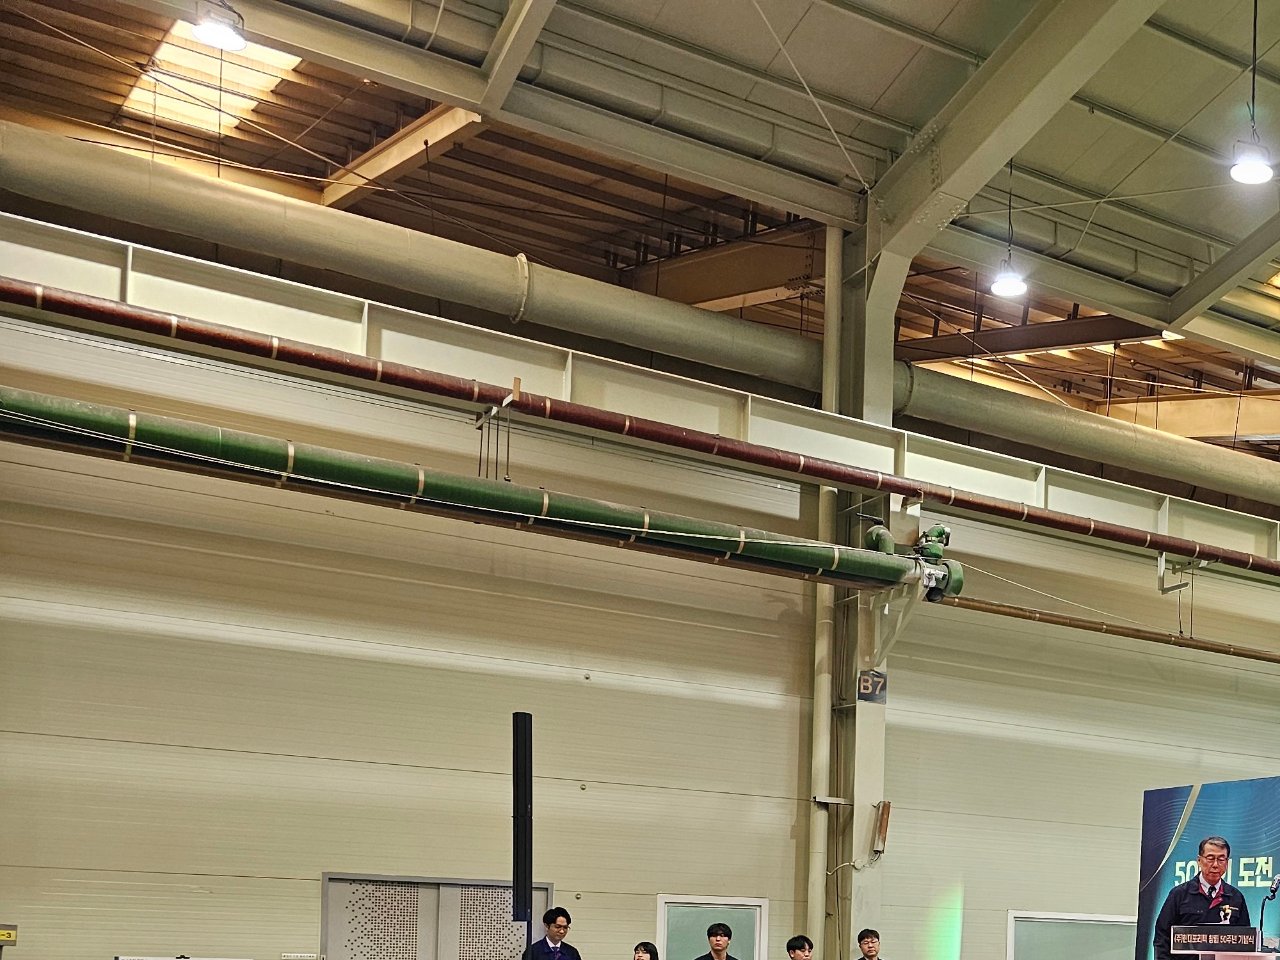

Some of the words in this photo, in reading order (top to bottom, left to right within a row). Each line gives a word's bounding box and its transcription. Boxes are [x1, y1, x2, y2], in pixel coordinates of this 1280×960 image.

[860, 675, 885, 694] B7
[1237, 857, 1273, 888] 도전
[1238, 934, 1255, 945] 기념식
